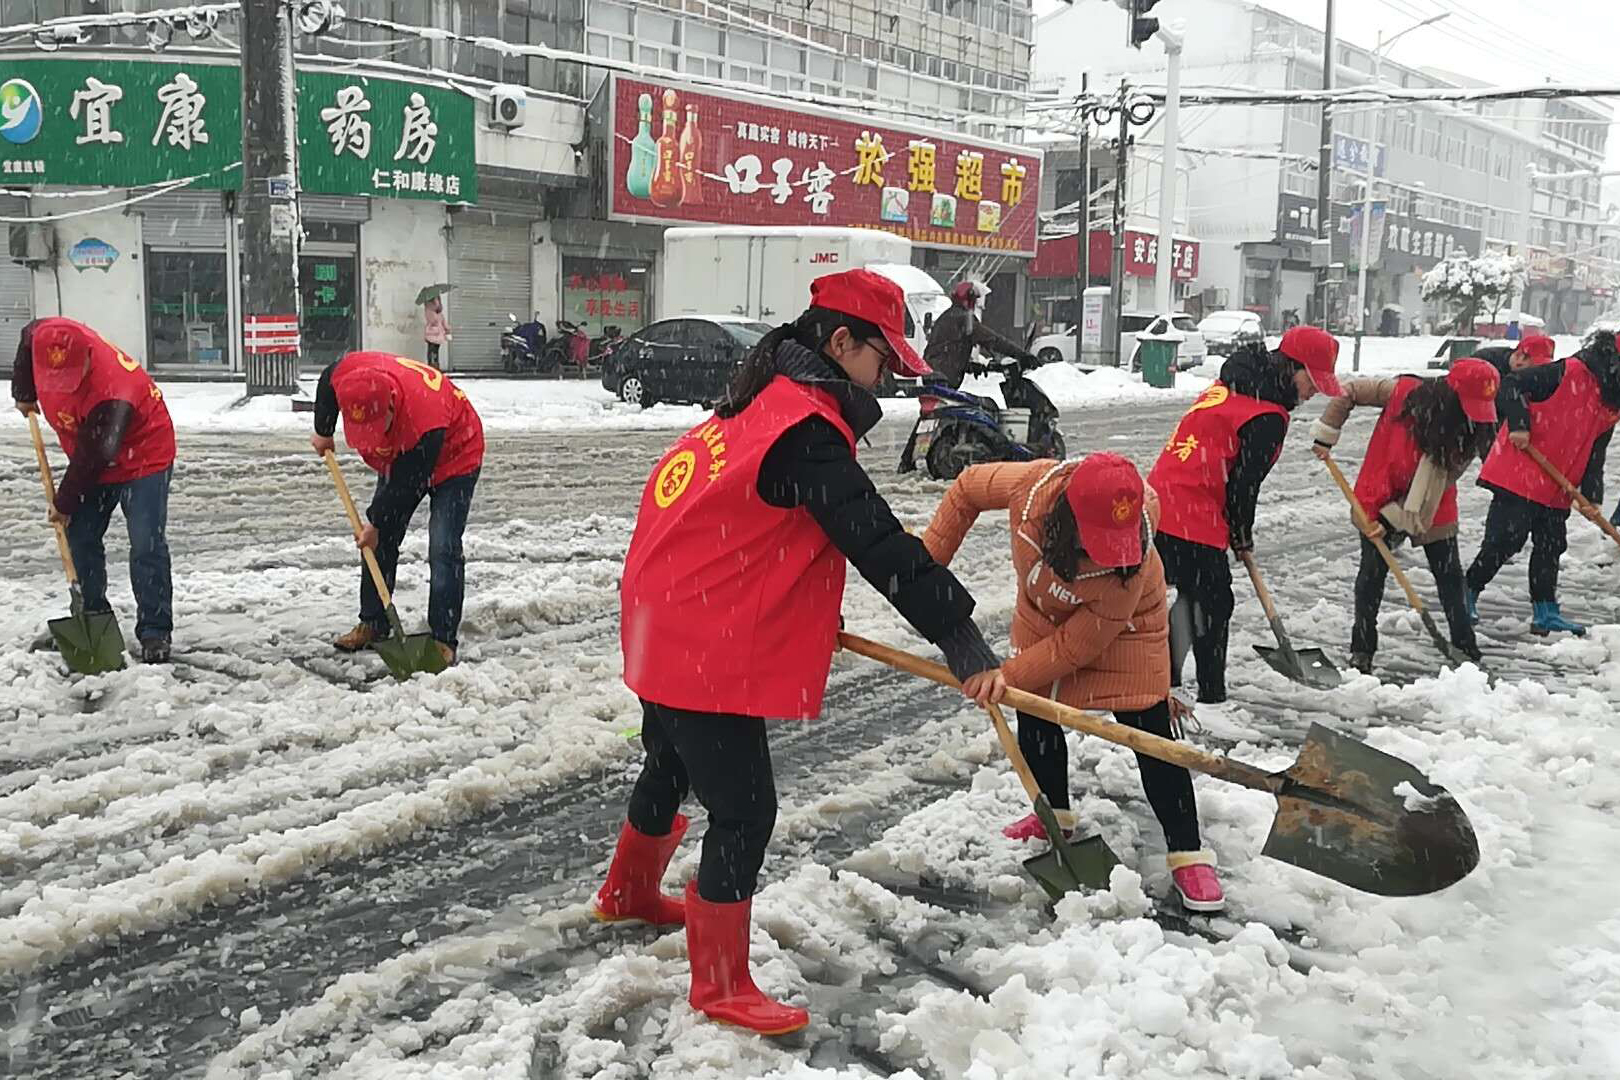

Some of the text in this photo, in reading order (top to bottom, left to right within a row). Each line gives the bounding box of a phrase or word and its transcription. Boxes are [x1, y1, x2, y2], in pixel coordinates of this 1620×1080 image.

[372, 167, 460, 196] 仁和康缘店
[724, 154, 837, 215] 口子窖
[809, 252, 839, 264] JMC
[1133, 236, 1194, 270] 安庆子店
